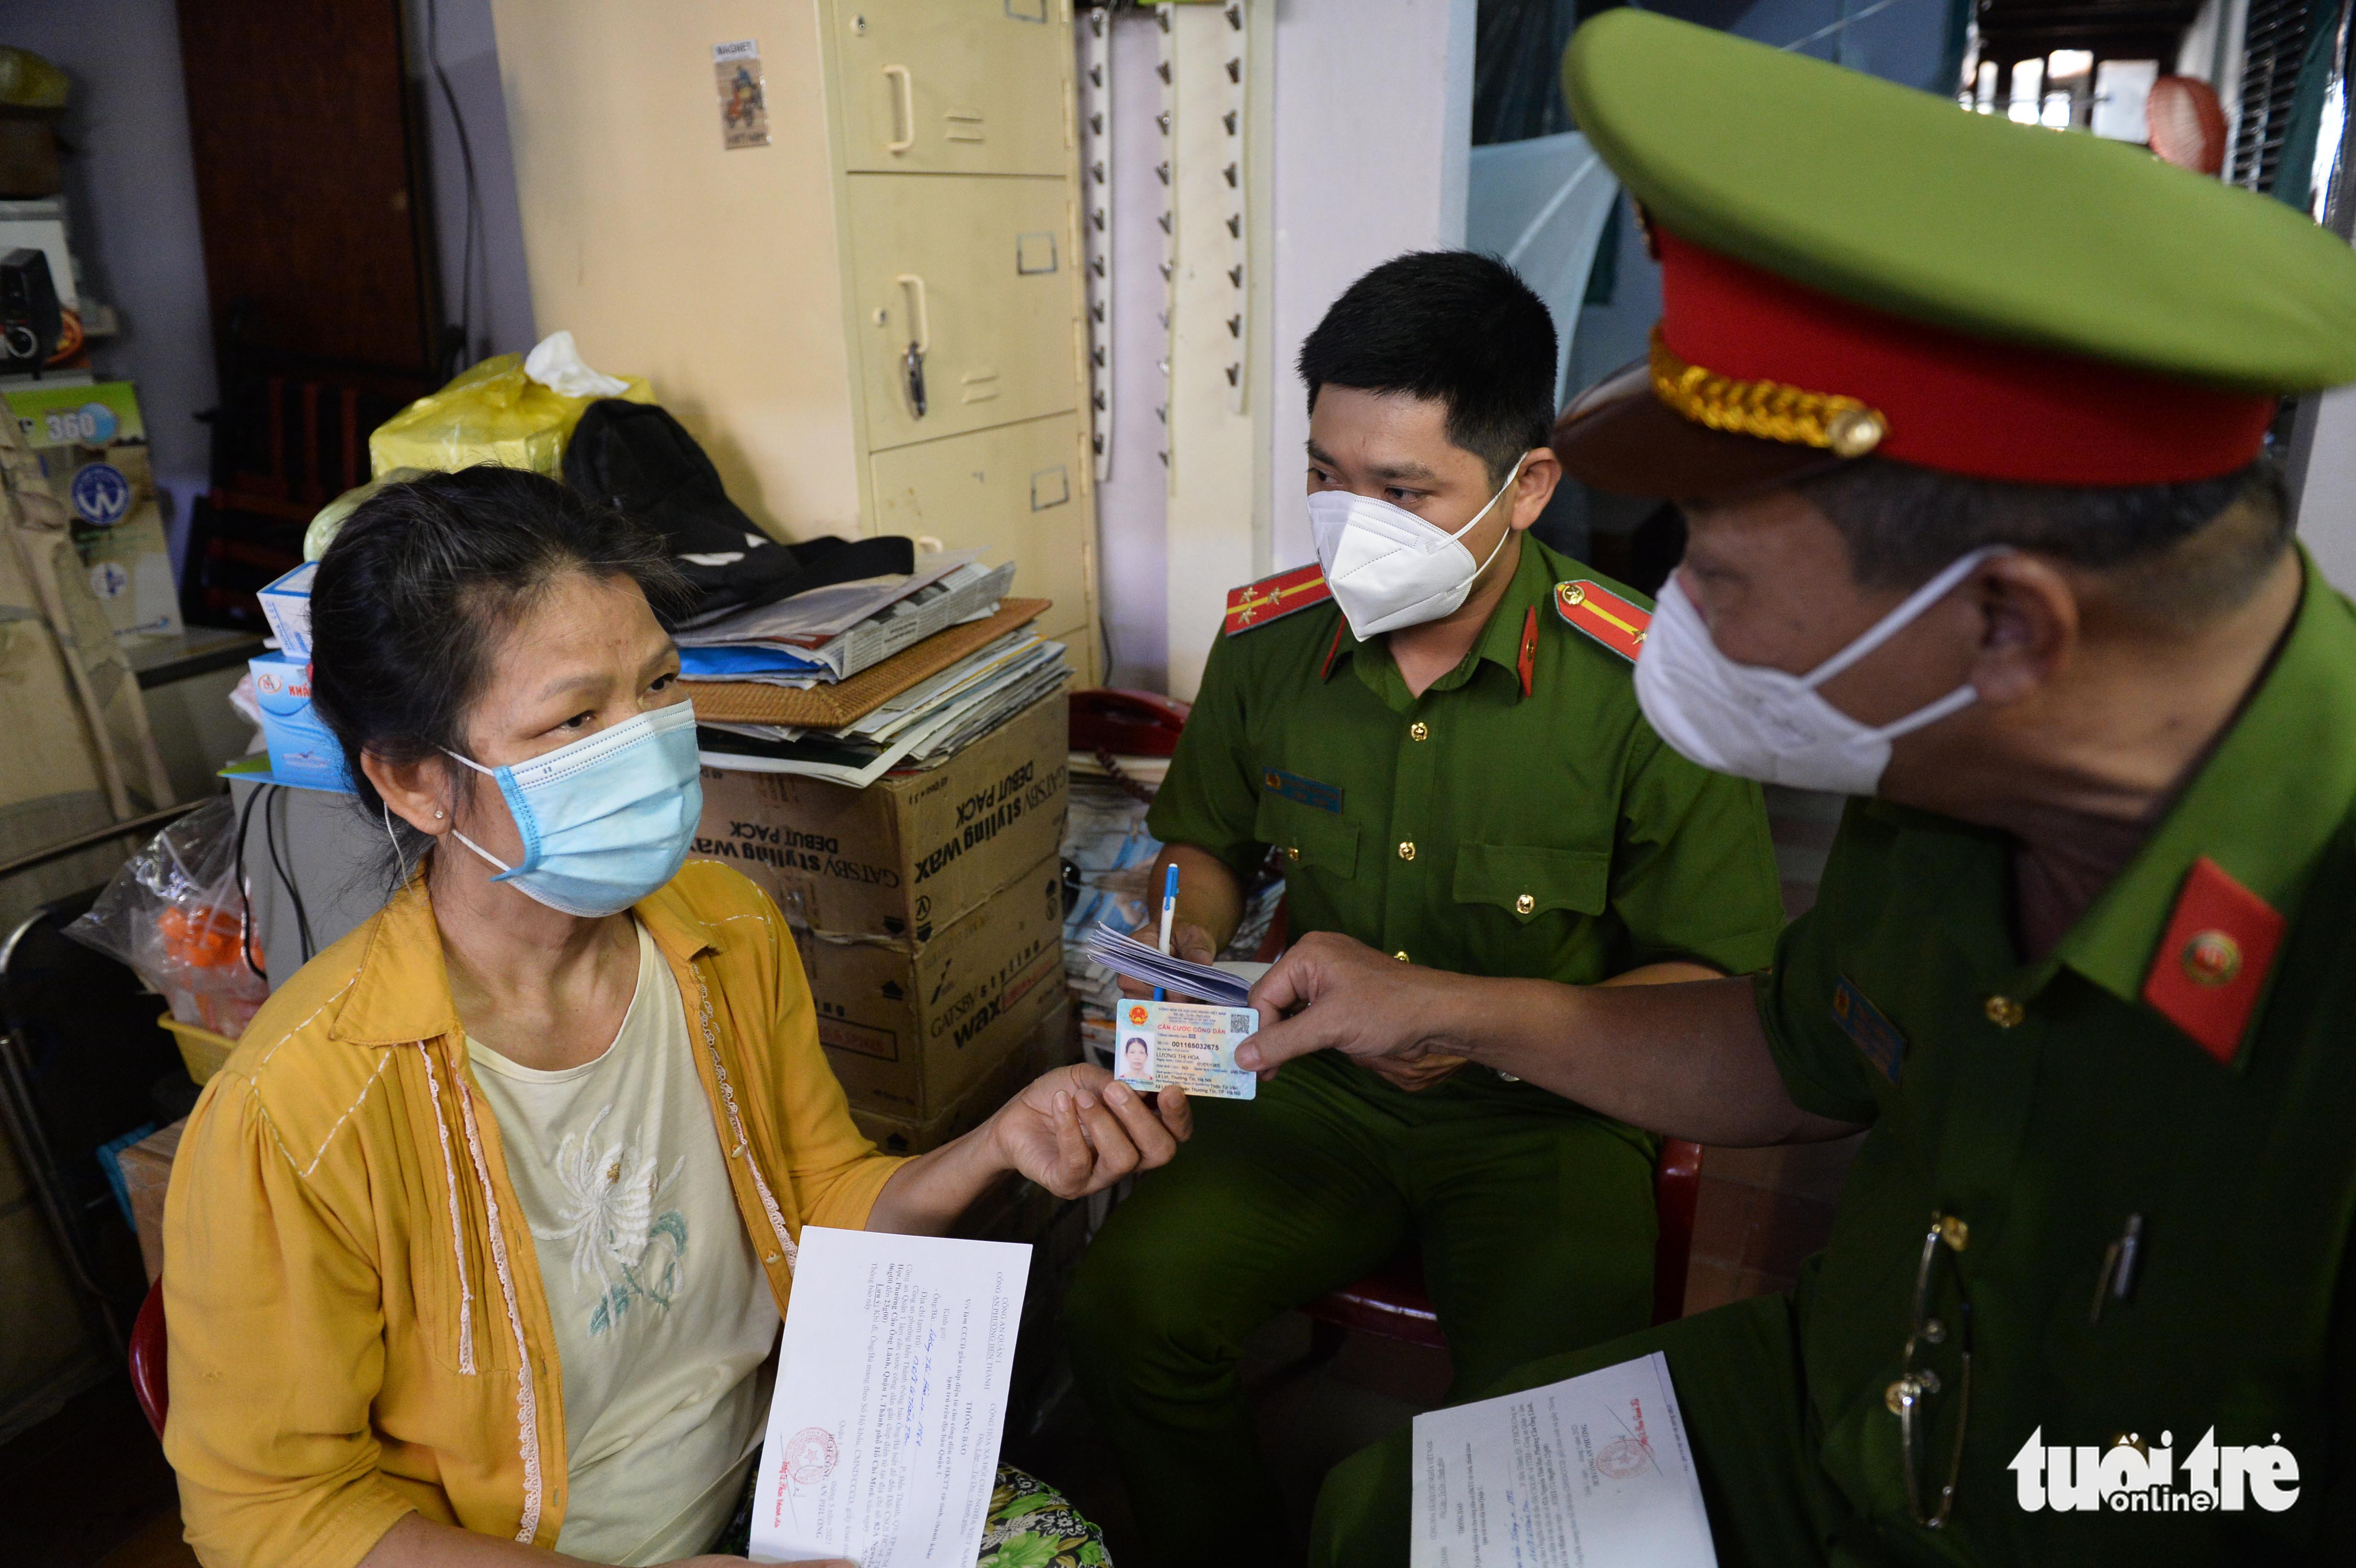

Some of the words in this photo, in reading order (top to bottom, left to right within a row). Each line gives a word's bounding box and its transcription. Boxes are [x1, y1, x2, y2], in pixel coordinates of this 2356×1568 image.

[46, 412, 95, 441] 360
[998, 761, 1033, 803] DEBUT
[956, 785, 995, 829] PACK
[731, 821, 780, 843] PACK
[964, 797, 1022, 850] styling
[690, 837, 738, 859] wa
[785, 831, 838, 854] DEBUT
[742, 841, 820, 871] styling
[914, 838, 962, 883] wax
[824, 855, 900, 888] GATSBY
[931, 988, 977, 1038] GATSBY
[953, 995, 1003, 1049] wax
[1172, 1041, 1219, 1050] 001165032675
[867, 1262, 877, 1283] Thông
[885, 1263, 895, 1284] 06g00
[903, 1263, 912, 1282] Công
[995, 1271, 1004, 1293] CÔNG
[885, 1285, 893, 1297] đến
[891, 1282, 901, 1309] Phường
[909, 1285, 918, 1303] Công
[918, 1291, 927, 1306] Địa
[899, 1295, 908, 1313] Quận
[1000, 1297, 1010, 1319] CÔNG
[890, 1312, 898, 1327] Cầu
[905, 1316, 915, 1342] phường
[914, 1319, 923, 1334] tạm
[989, 1308, 1000, 1341] PHƯỜNG
[886, 1328, 897, 1345] Ông
[960, 1326, 968, 1349] CCCD
[994, 1334, 1005, 1358] QUẬN
[904, 1344, 912, 1358] Bến
[862, 1364, 871, 1383] mang
[881, 1371, 890, 1392] Quận
[889, 1372, 898, 1389] công
[901, 1361, 909, 1382] Thành
[954, 1365, 963, 1380] chip
[984, 1362, 994, 1390] THÀNH
[896, 1385, 906, 1405] thông
[952, 1382, 961, 1397] điện
[877, 1403, 886, 1427] Thành
[962, 1402, 974, 1433] THÔNG
[873, 1430, 883, 1444] phố
[883, 1423, 892, 1439] chip
[940, 1421, 949, 1432] địa
[947, 1423, 956, 1439] công
[960, 1436, 969, 1455] BÁO
[936, 1449, 945, 1469] Quận
[978, 1461, 989, 1478] HỘI
